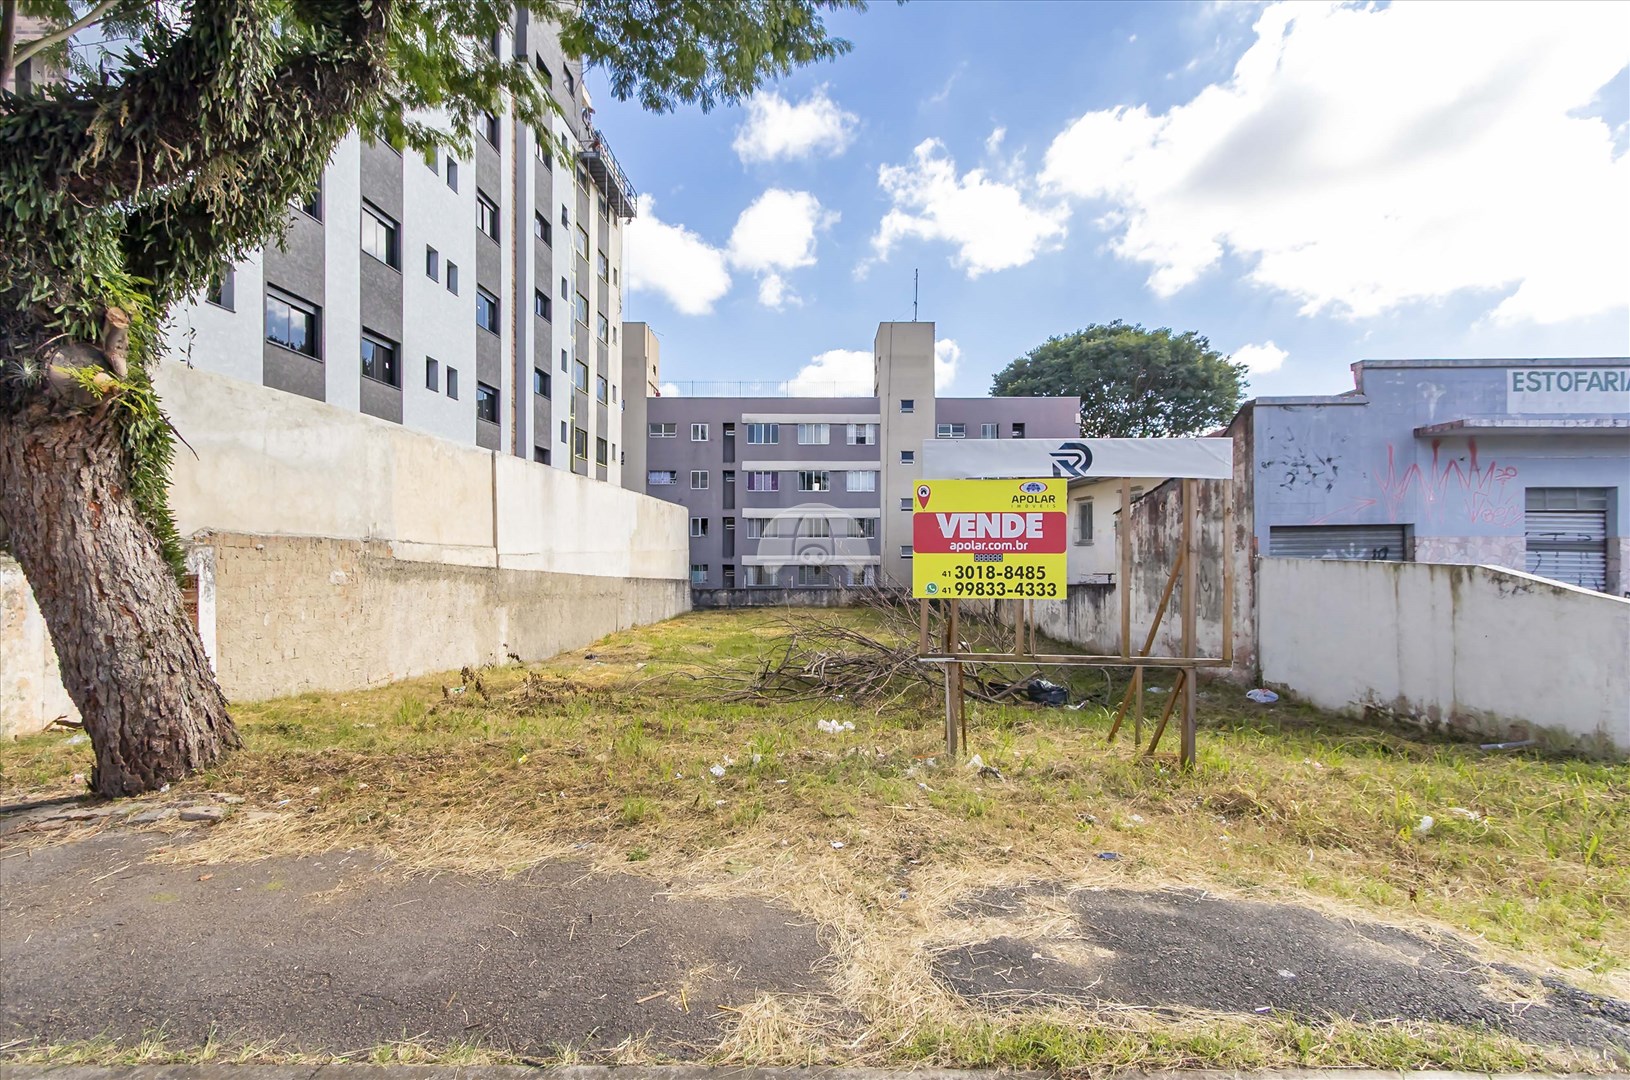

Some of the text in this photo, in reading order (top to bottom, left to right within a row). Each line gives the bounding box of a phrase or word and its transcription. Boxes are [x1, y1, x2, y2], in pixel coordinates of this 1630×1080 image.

[1513, 371, 1630, 392] ESTOFARI
[1011, 495, 1056, 504] APOLAR
[935, 513, 1044, 539] VENDE
[949, 540, 1029, 552] apolar.com.br
[954, 565, 1046, 580] 3018-8485
[954, 582, 1057, 597] 99833-4333
